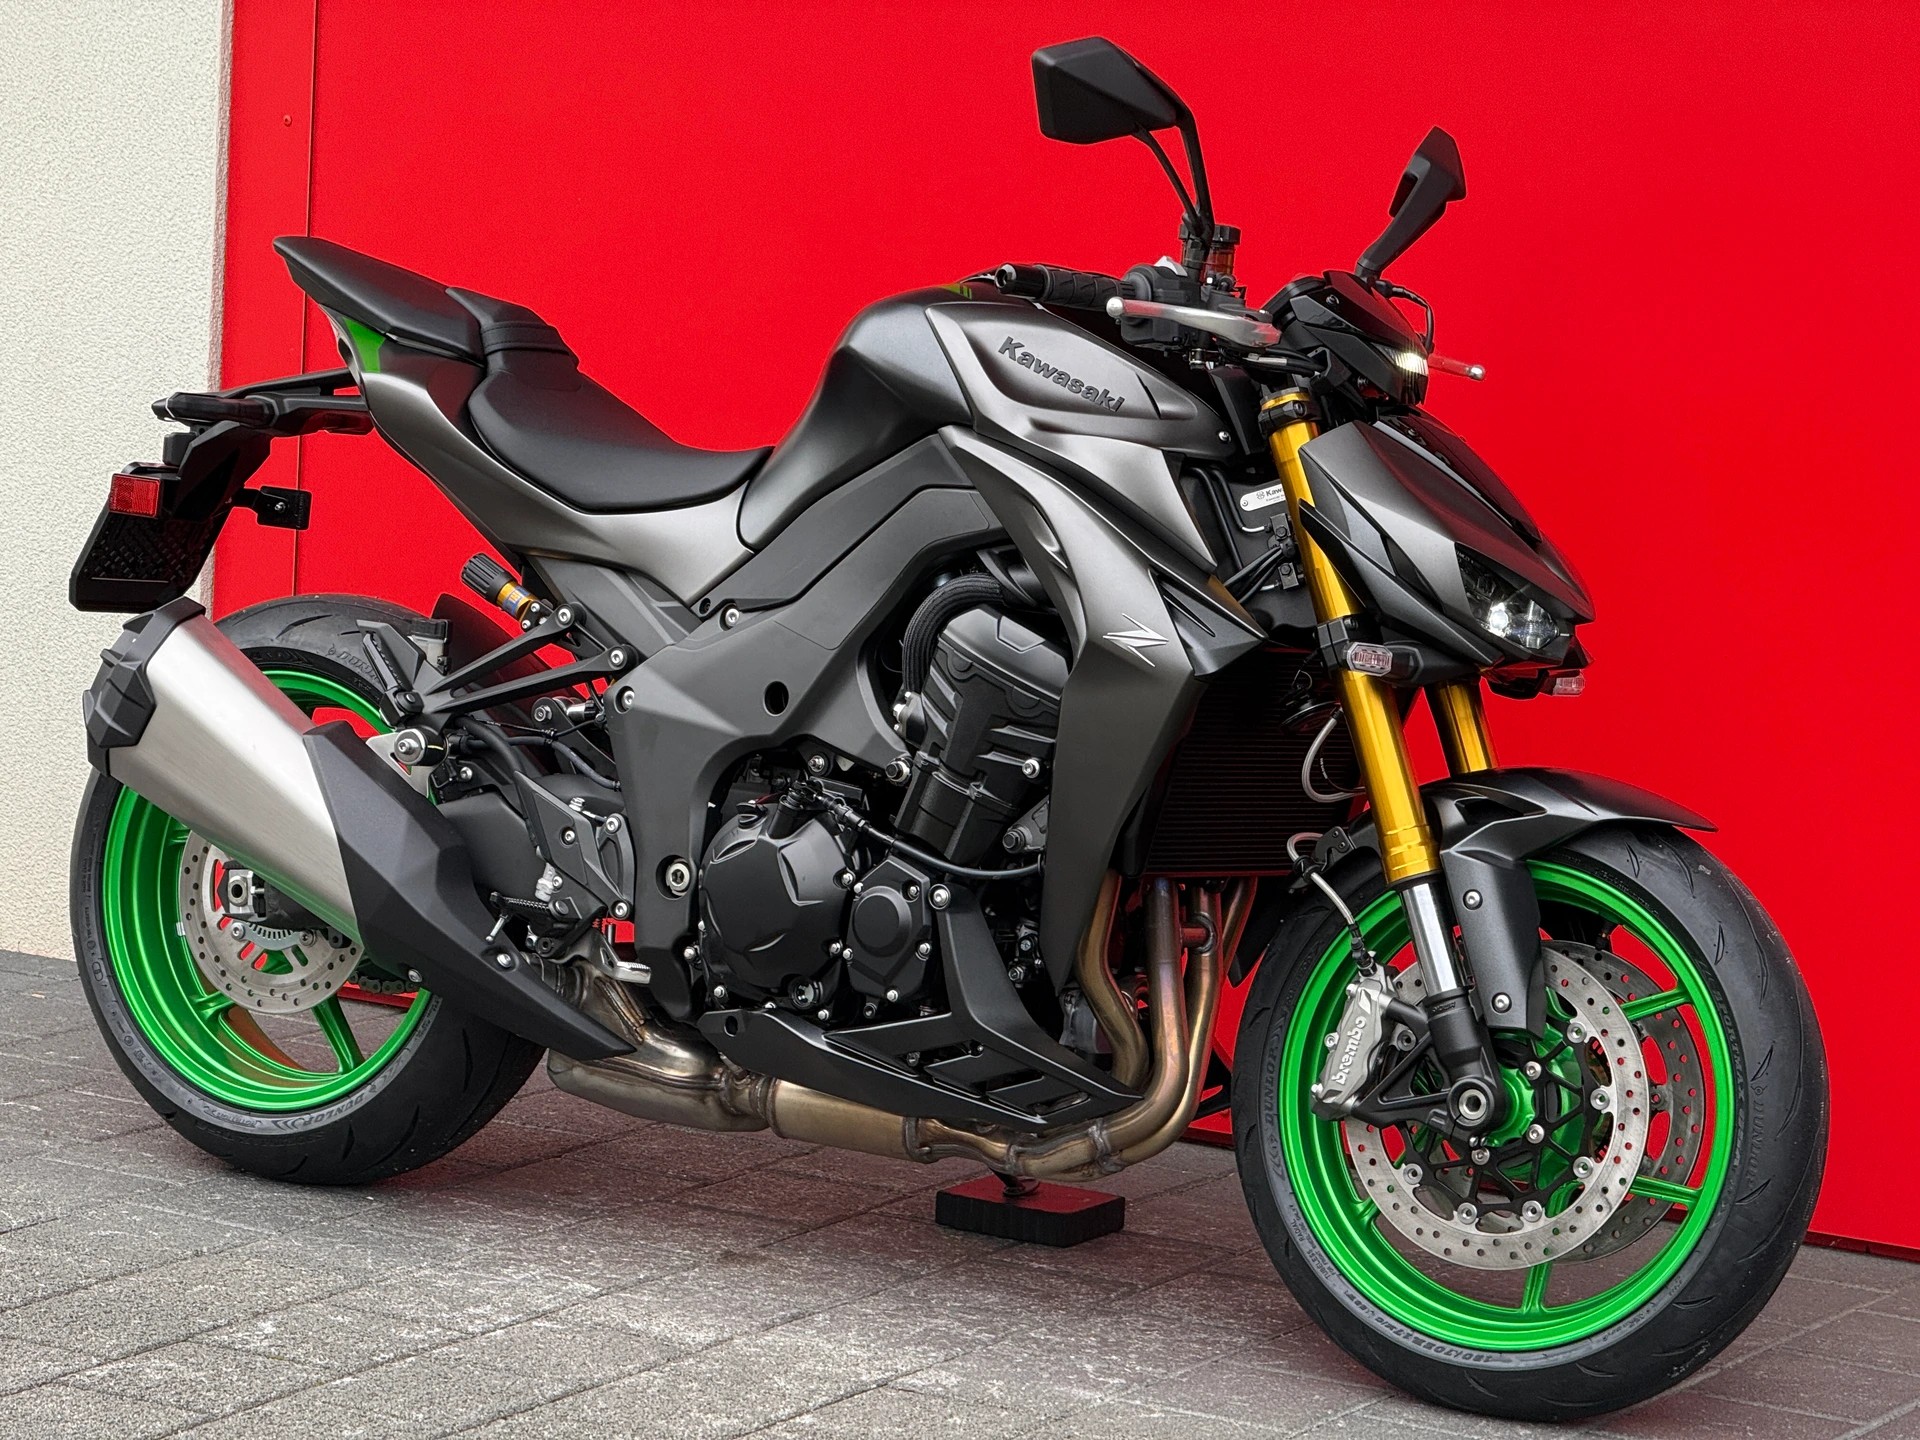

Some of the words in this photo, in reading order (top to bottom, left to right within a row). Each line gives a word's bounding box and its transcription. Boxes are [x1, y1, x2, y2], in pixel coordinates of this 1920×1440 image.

[998, 336, 1126, 412] Kawasaki
[1331, 1015, 1367, 1085] brembo
[1713, 988, 1745, 1101] SPORTMAX
[302, 1092, 366, 1128] DUNLOP
[1264, 1046, 1280, 1127] DUNLOP
[1290, 1218, 1305, 1242] RADIAL
[1306, 1248, 1331, 1280] TUBELESS
